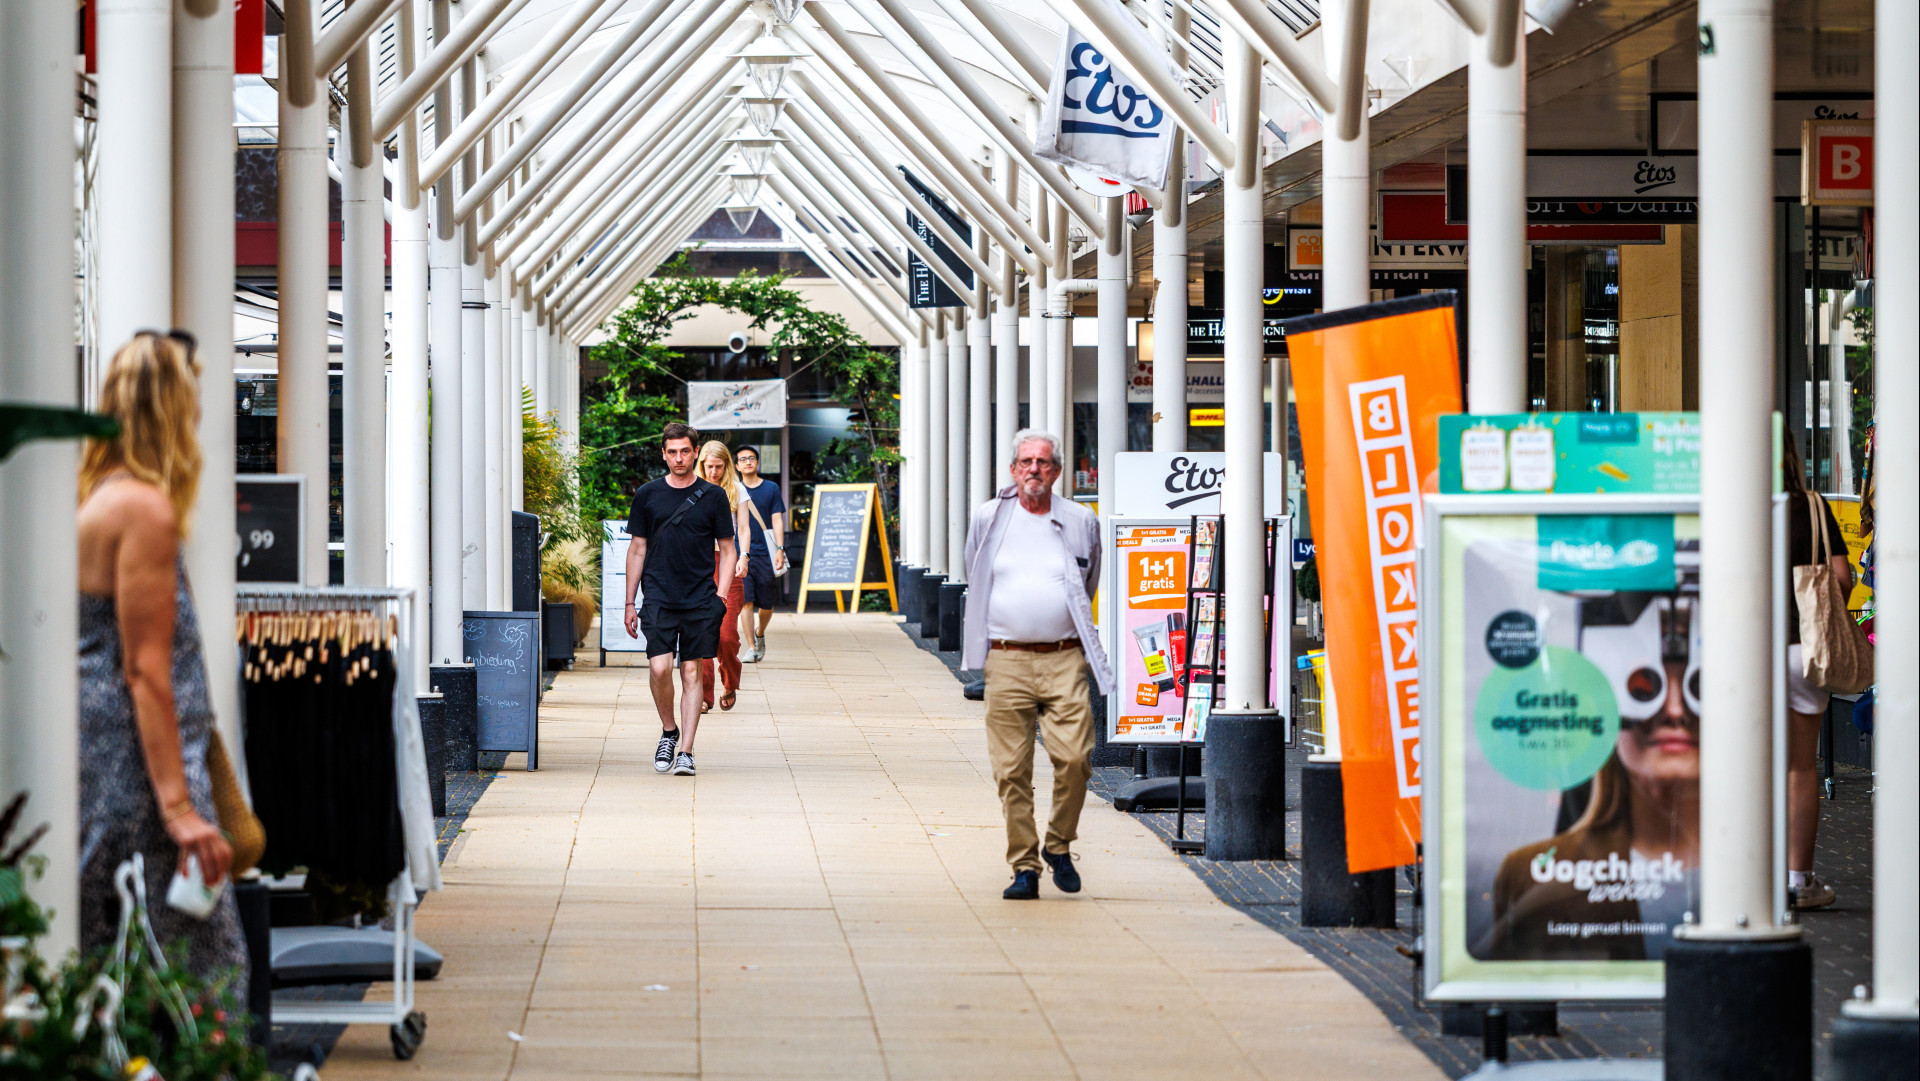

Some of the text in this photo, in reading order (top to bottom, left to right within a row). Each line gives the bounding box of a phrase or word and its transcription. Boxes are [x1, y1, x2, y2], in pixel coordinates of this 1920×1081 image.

[1063, 42, 1164, 129] Etos
[1633, 160, 1676, 185] Etos
[1832, 144, 1861, 180] B
[1297, 235, 1322, 246] CO
[917, 280, 930, 305] THE
[1188, 323, 1206, 336] HE
[1133, 376, 1153, 386] GS
[1139, 556, 1175, 578] 1+1
[1140, 576, 1175, 592] gratis
[1516, 690, 1579, 709] Gratis
[1491, 713, 1604, 735] oogmeting
[1530, 850, 1684, 890] Oogcheck
